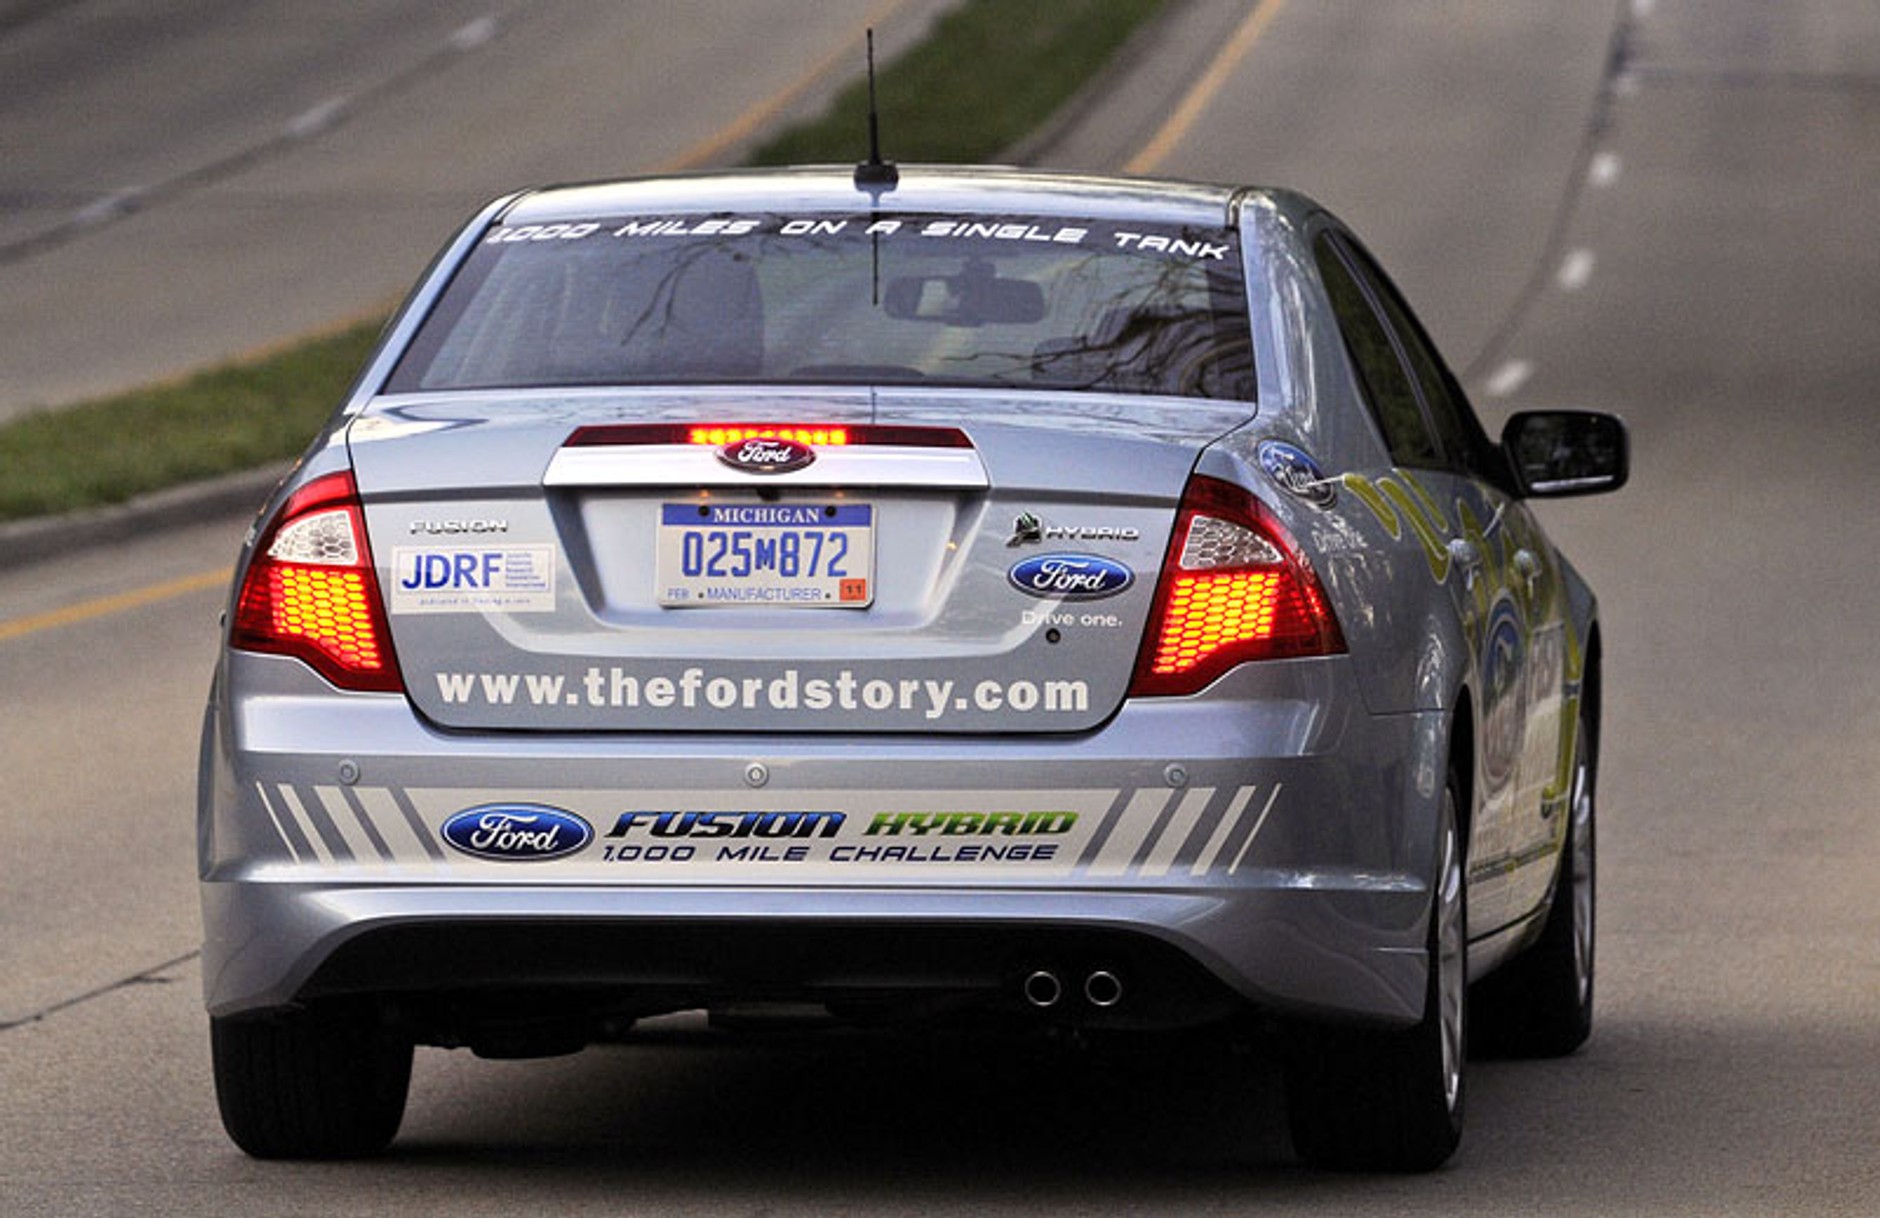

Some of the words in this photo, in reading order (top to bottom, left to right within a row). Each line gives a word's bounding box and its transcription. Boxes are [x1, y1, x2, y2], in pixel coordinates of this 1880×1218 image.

[613, 220, 760, 238] MILES
[779, 220, 847, 236] ON
[865, 220, 903, 236] A
[921, 220, 1088, 244] SINGLE
[1113, 231, 1230, 261] TANK
[738, 441, 792, 462] Ford
[713, 507, 820, 524] MICHIGAN
[409, 518, 509, 535] FUSION
[1045, 525, 1140, 541] HYBRID
[682, 531, 848, 578] 025M872
[401, 553, 503, 589] JDRF
[1032, 558, 1107, 591] Ford
[707, 587, 822, 601] MANUFACTURER
[845, 584, 862, 595] 11
[1022, 611, 1074, 626] Drive
[1080, 613, 1123, 627] one.
[436, 668, 1089, 718] www.thefordstory.com
[470, 812, 560, 851] Ford
[603, 810, 847, 839] FUSION
[862, 810, 1080, 837] HYBRID
[602, 845, 696, 864] 1,000
[716, 845, 810, 863] MILE
[828, 843, 1060, 864] CHALLENGE
